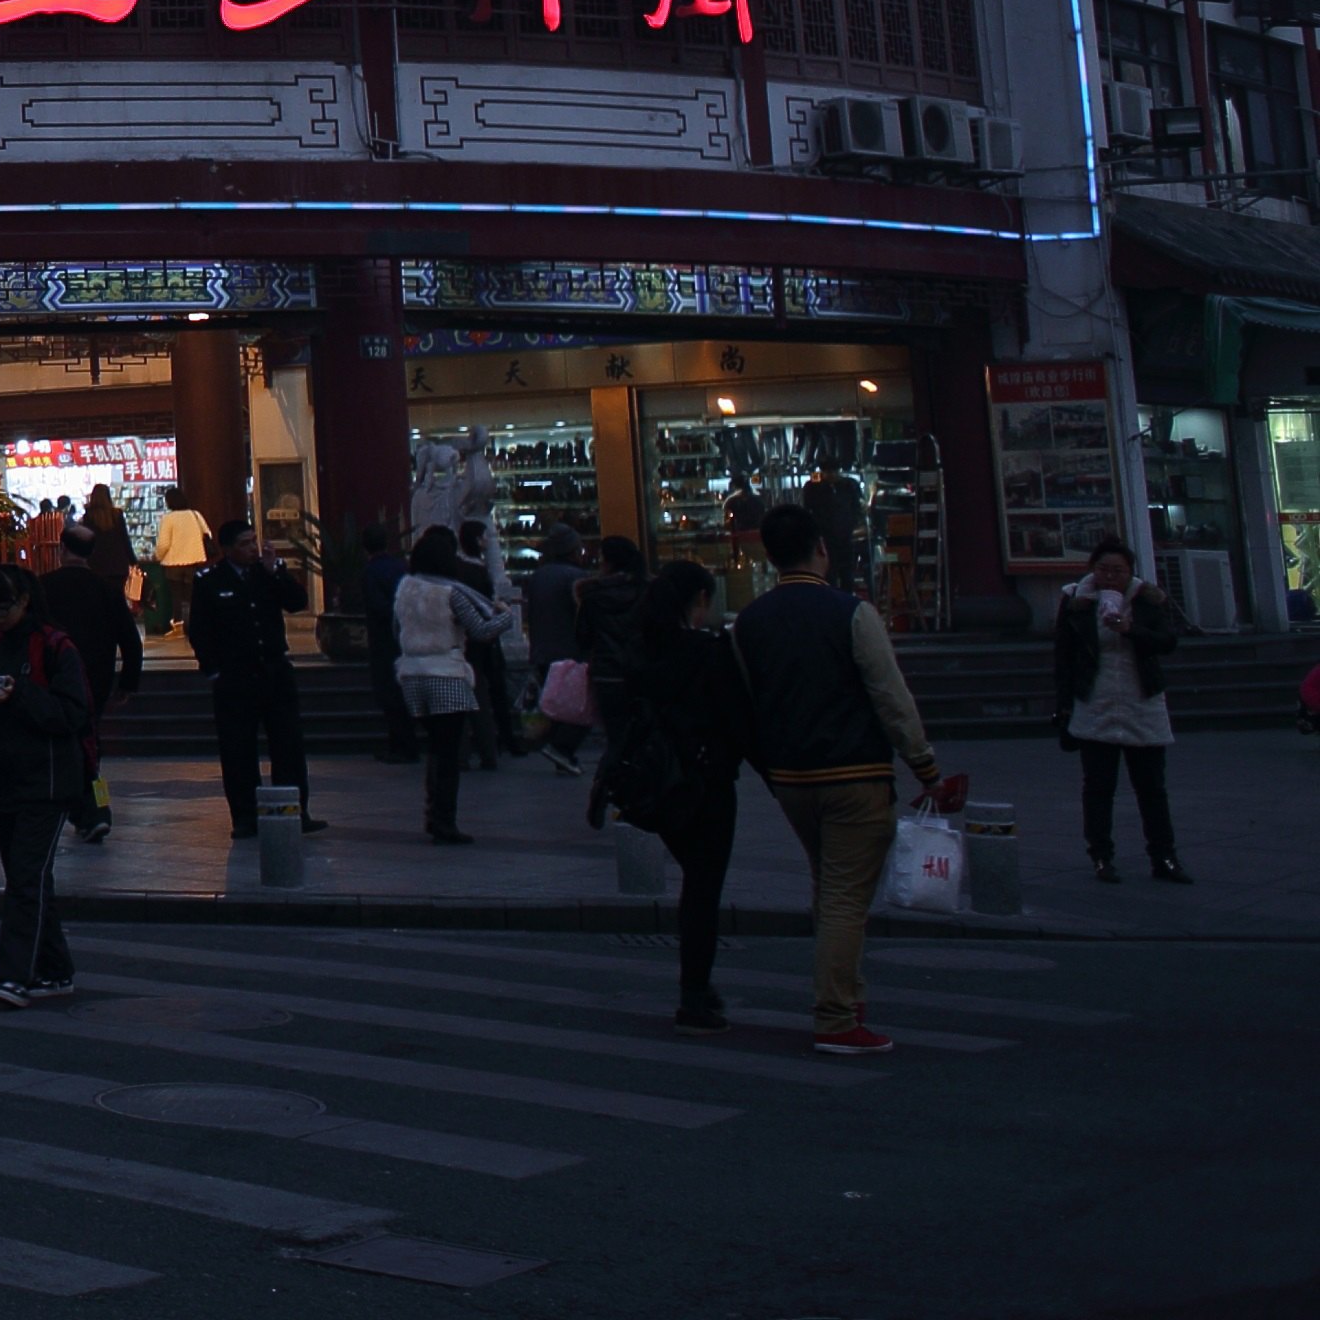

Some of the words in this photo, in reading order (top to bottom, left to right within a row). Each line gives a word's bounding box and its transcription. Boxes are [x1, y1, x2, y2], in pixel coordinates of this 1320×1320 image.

[79, 442, 138, 464] 手机贴膜
[125, 460, 177, 481] 手机贴
